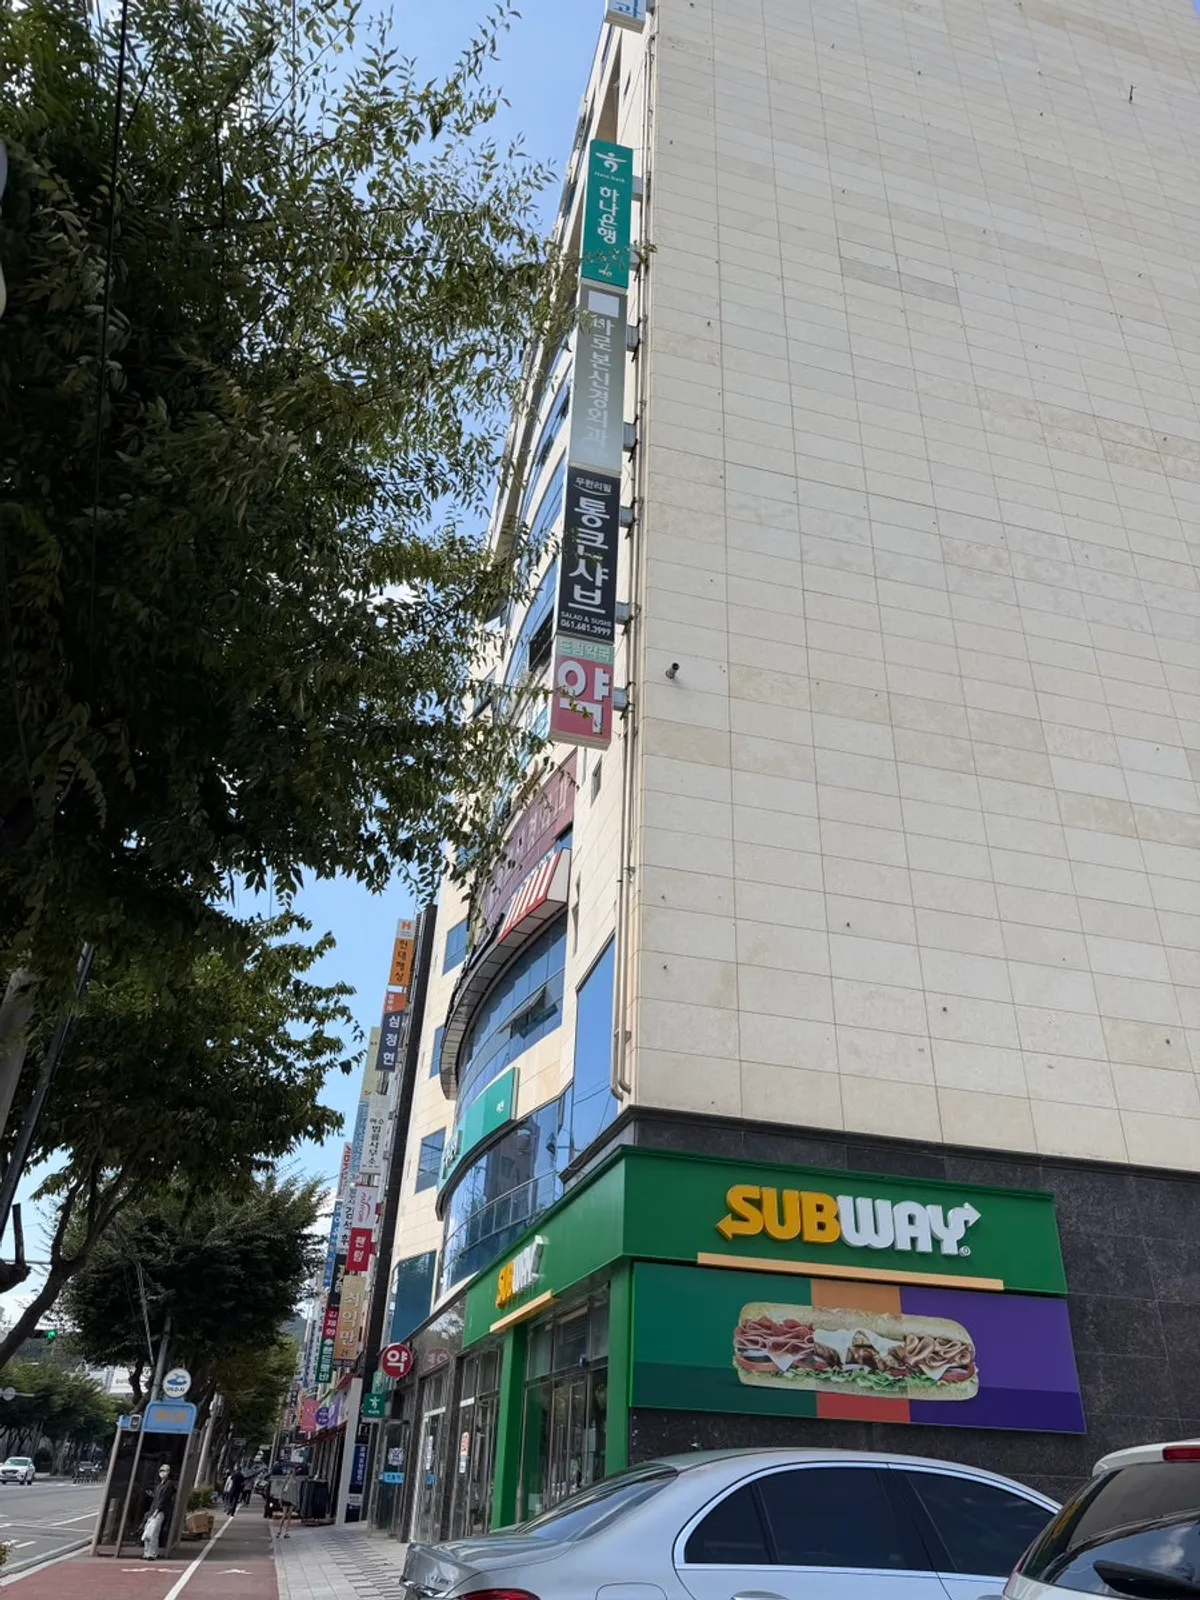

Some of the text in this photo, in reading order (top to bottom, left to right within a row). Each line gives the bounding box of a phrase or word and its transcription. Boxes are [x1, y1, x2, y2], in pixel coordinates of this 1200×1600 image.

[597, 186, 620, 244] 하나은행
[575, 477, 612, 493] 무한리필
[568, 496, 611, 614] 통큰샤브
[557, 660, 610, 734] 약
[394, 939, 408, 982] 현대해상
[382, 1015, 400, 1067] 심정현
[716, 1184, 982, 1256] SUBWAY
[386, 1349, 408, 1373] 약
